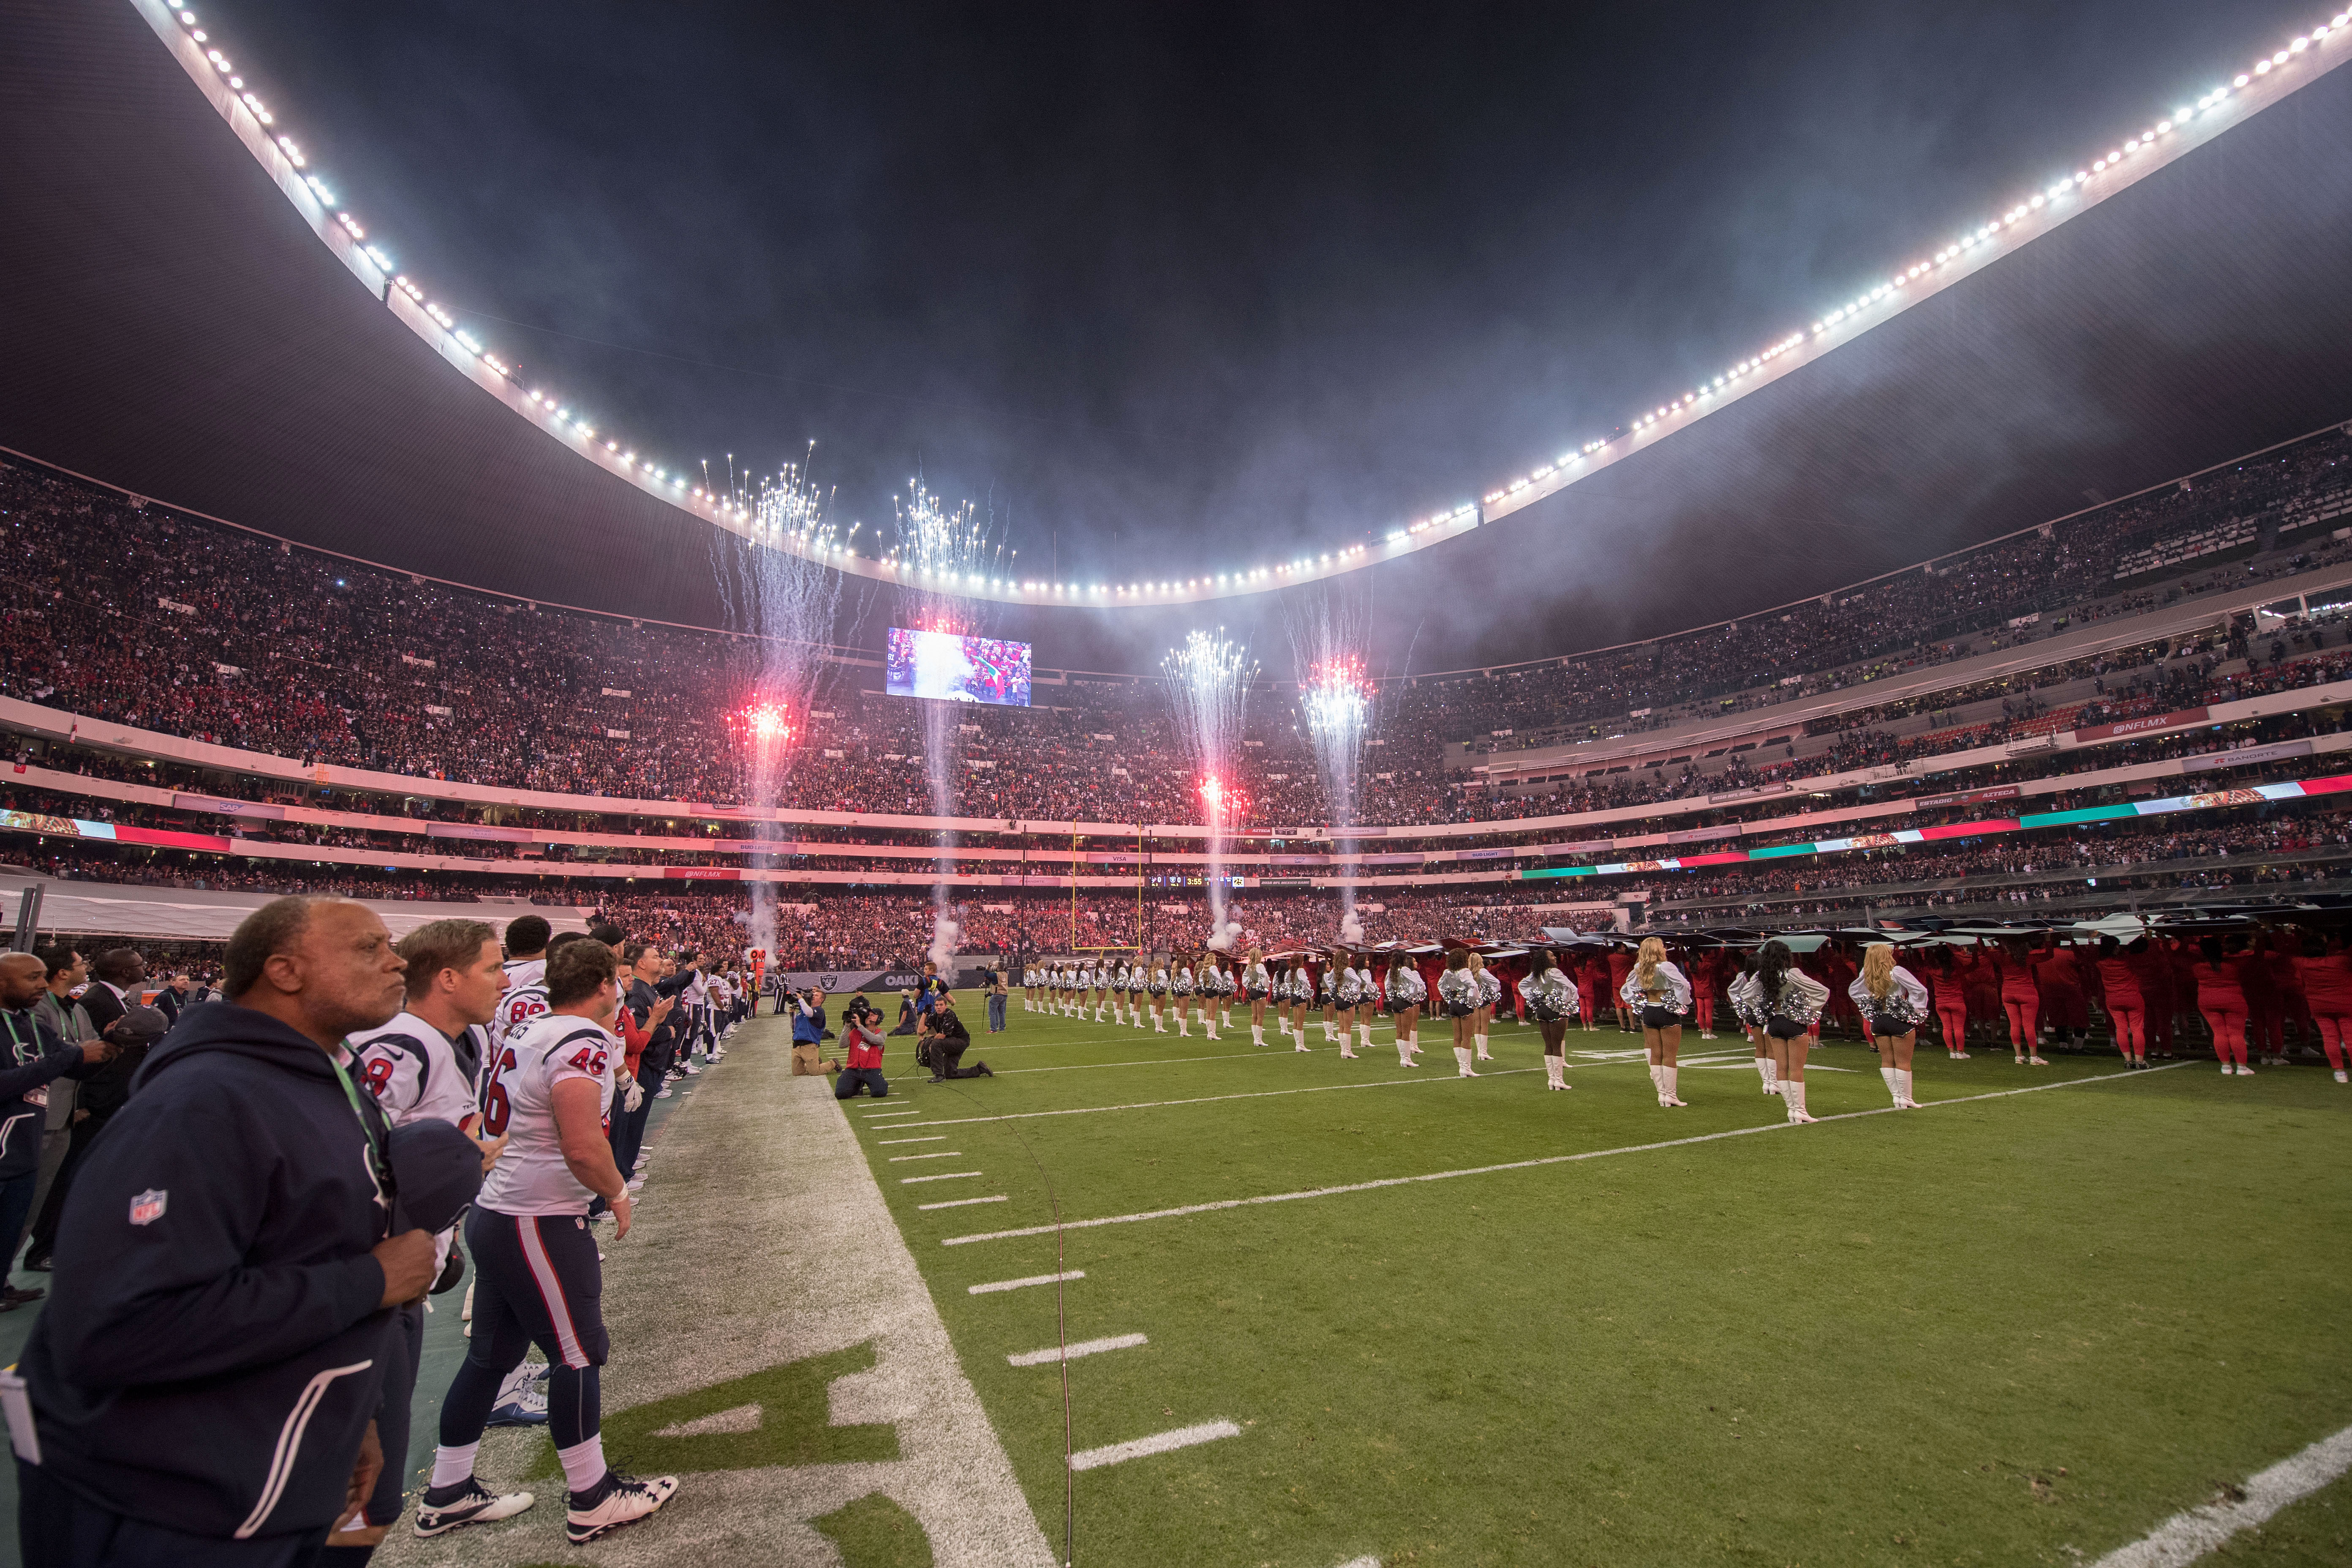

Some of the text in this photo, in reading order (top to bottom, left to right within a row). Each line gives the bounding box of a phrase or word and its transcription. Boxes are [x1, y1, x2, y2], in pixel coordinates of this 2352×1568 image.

[2112, 716, 2167, 734] @NFLMX
[2228, 751, 2278, 762] BANORTE
[1919, 789, 2015, 806] ESTADIO AZTECA
[568, 1047, 607, 1075] 46
[484, 1043, 517, 1138] 6
[133, 1203, 161, 1221] NFL
